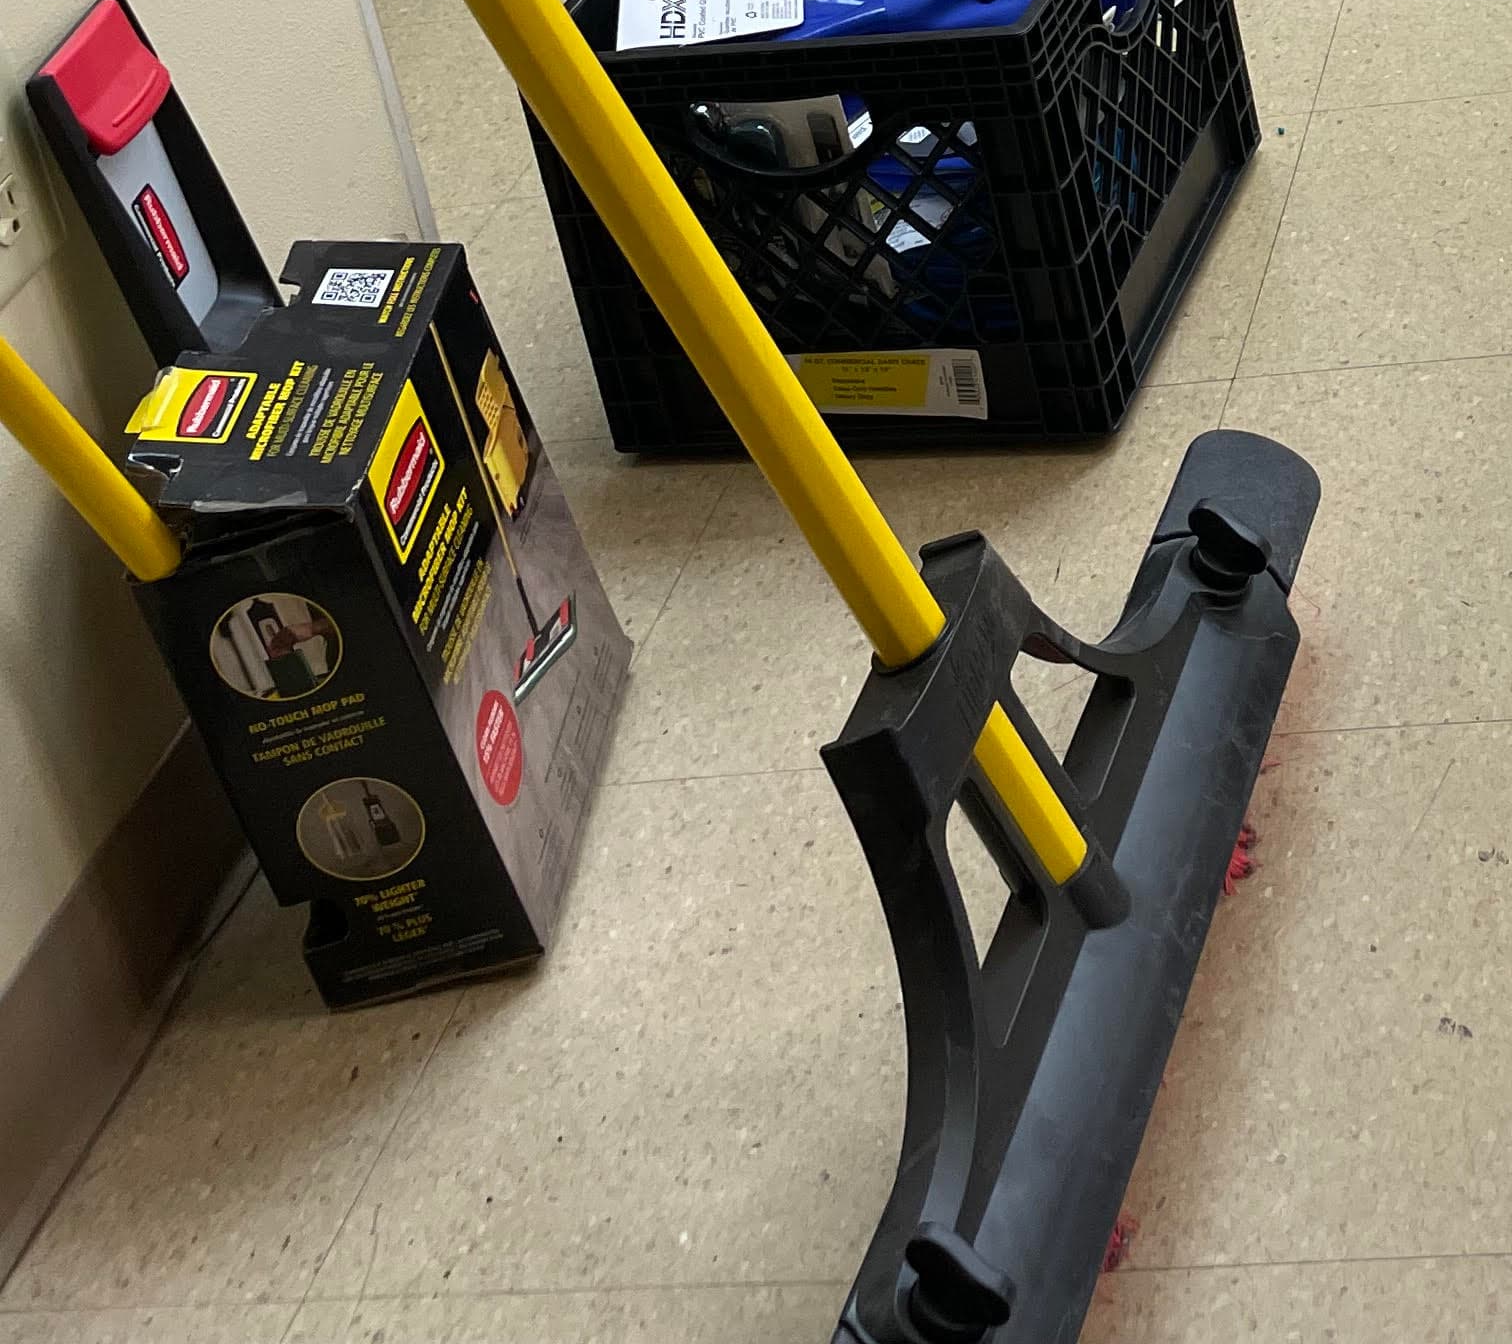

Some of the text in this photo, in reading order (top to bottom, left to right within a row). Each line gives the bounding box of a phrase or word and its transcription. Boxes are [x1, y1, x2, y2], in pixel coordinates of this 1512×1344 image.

[186, 379, 222, 434] Rubbermaid
[246, 382, 281, 439] ADAPTABLE
[249, 360, 306, 461] MICROFIBER MOP KIT
[388, 431, 426, 514] Rubbermaid
[412, 541, 447, 625] MICROFIBER
[456, 485, 469, 514] KIT
[418, 502, 451, 583] ADAPTABLE
[311, 700, 338, 716] MOP
[341, 693, 365, 707] PAD
[251, 742, 300, 763] TAMPON
[318, 716, 386, 743] VADROUILLE
[314, 735, 364, 757] CONTACT
[379, 879, 427, 898] LIGHTER
